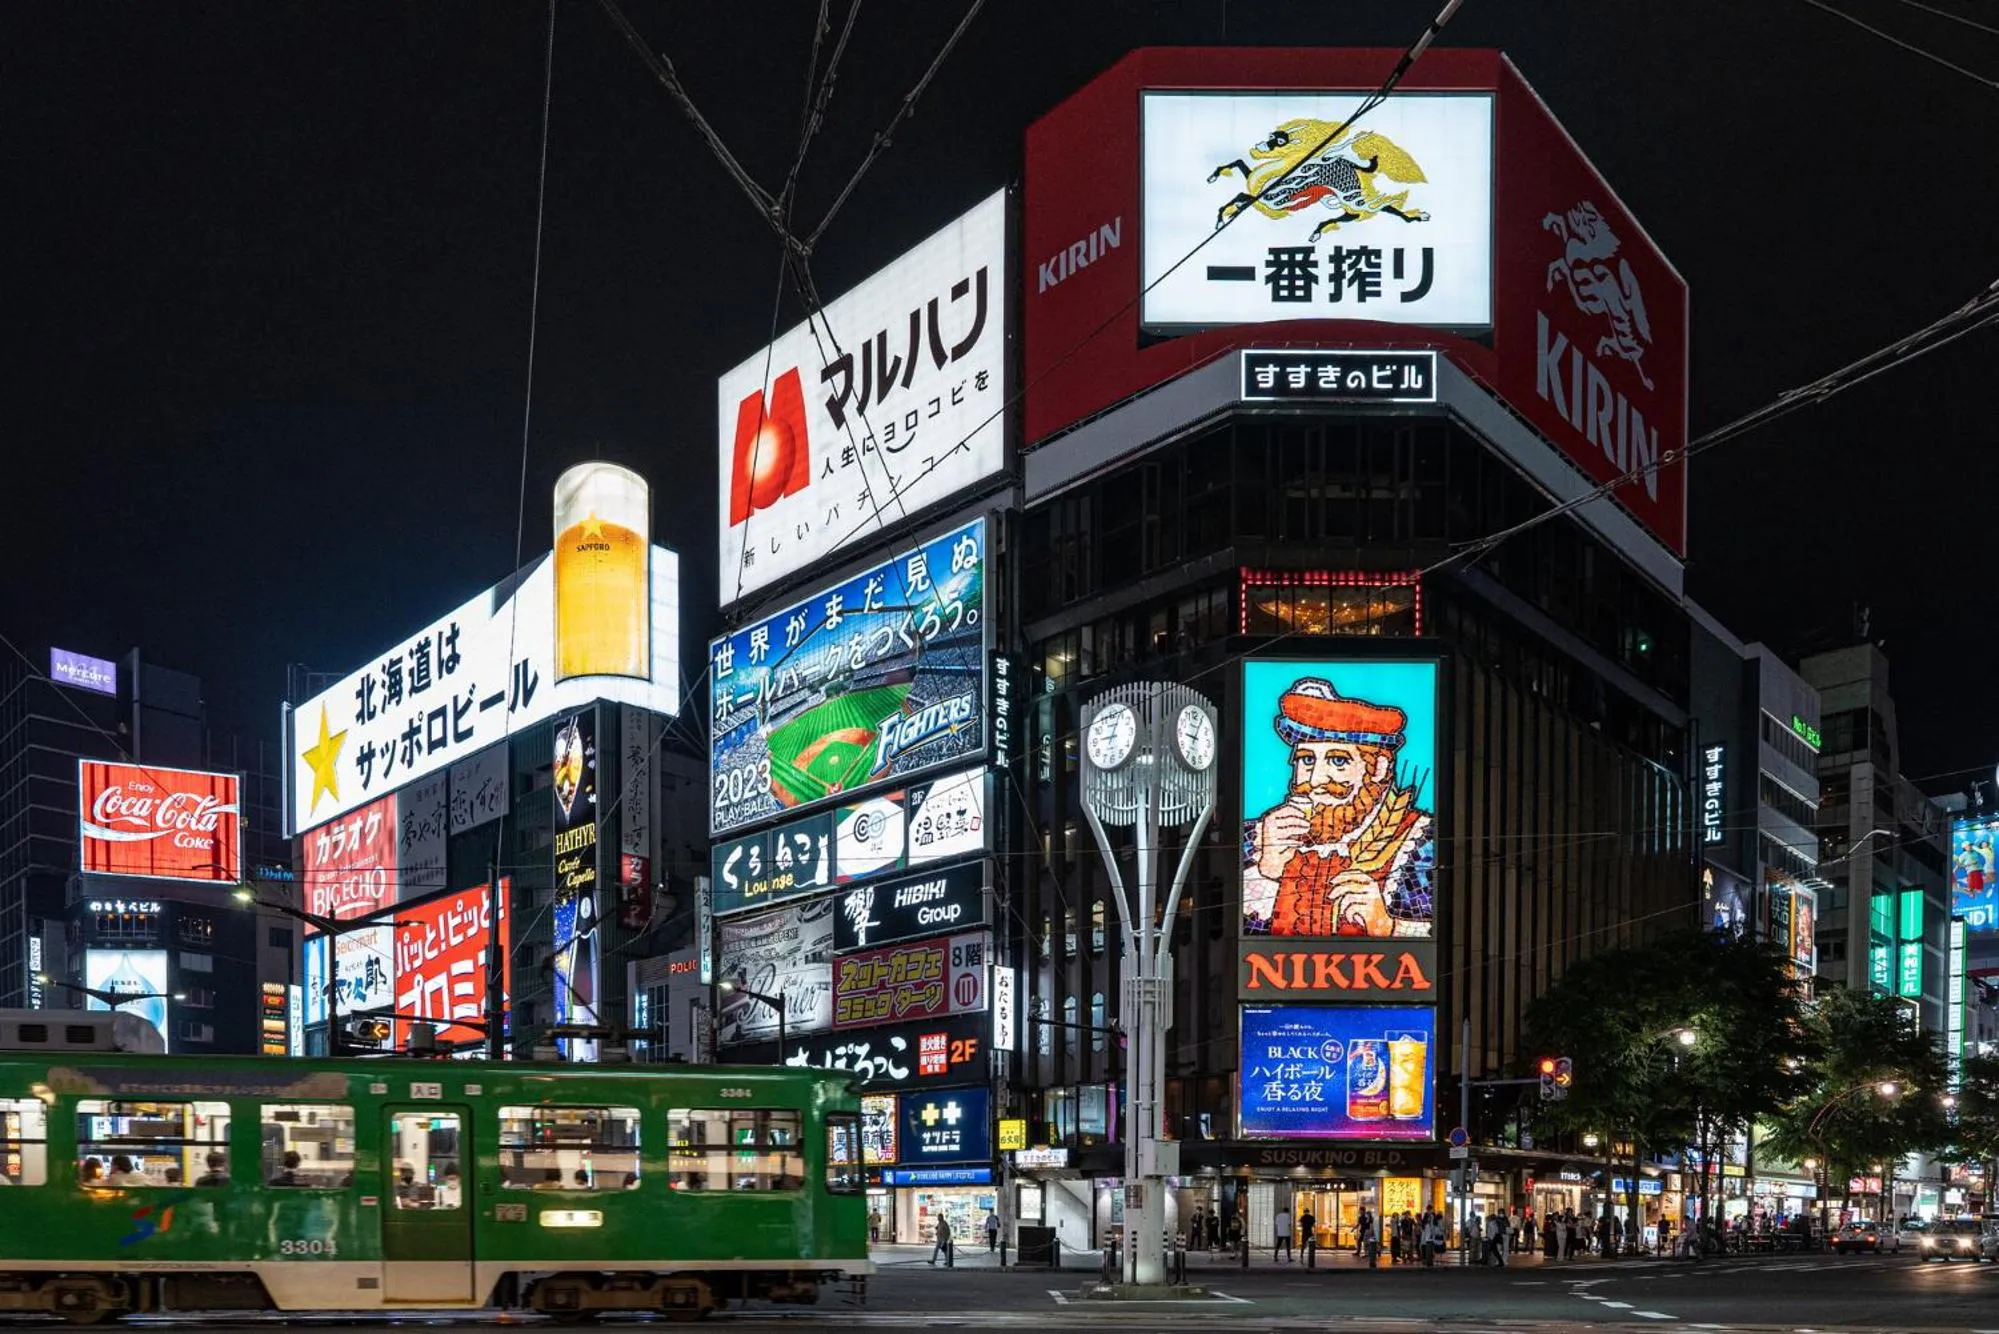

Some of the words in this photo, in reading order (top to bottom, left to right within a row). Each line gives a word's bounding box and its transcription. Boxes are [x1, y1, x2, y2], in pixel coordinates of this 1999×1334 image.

[1038, 215, 1121, 293] KIRIN
[1207, 245, 1435, 305] 一番搾り
[821, 266, 989, 430] マルハン
[1255, 363, 1423, 391] すすきのビル
[1536, 310, 1659, 500] KIRIN
[822, 370, 989, 480] 人生にヨロコビを
[744, 440, 970, 568] 新しいパチンコへ
[577, 543, 610, 552] SAPPORO
[715, 535, 978, 679] 世界がまだ見ぬ
[56, 662, 111, 682] Mercure
[715, 592, 978, 722] ボールパークをつくろう。
[355, 622, 461, 726] 北海道は
[355, 658, 539, 791] サッポロビール
[870, 693, 974, 776] FIGHTERS
[128, 780, 155, 793] Enjoy
[715, 759, 772, 808] 2023
[912, 791, 925, 806] 2F
[93, 786, 219, 832] Coca-Cola
[715, 806, 740, 827] PLAY
[745, 798, 770, 815] BALL
[173, 831, 213, 849] Coke
[316, 811, 383, 866] カラオケ
[555, 822, 596, 856] HATHYR
[313, 884, 341, 915] BIG
[343, 866, 386, 903] ECHO
[744, 873, 793, 897] Lounge
[894, 880, 946, 908] HIBIKI
[917, 903, 961, 925] Group
[952, 942, 982, 967] 8階
[839, 951, 943, 992] ネットカフェ
[1244, 952, 1432, 990] NIKKA
[398, 950, 509, 1041] プロミ
[838, 993, 891, 1023] コミック
[897, 985, 942, 1015] ダーツ
[951, 1040, 977, 1062] 2F
[1268, 1046, 1319, 1059] BLACK
[1250, 1063, 1335, 1080] ハイボール
[415, 1085, 437, 1097] 入口
[720, 1088, 752, 1097] 3304
[1262, 1081, 1324, 1101] 香る夜
[922, 1131, 961, 1146] サツドラ
[1261, 1151, 1356, 1165] SUSUKINO
[1364, 1151, 1406, 1165] BLD.
[280, 1240, 337, 1256] 3304
